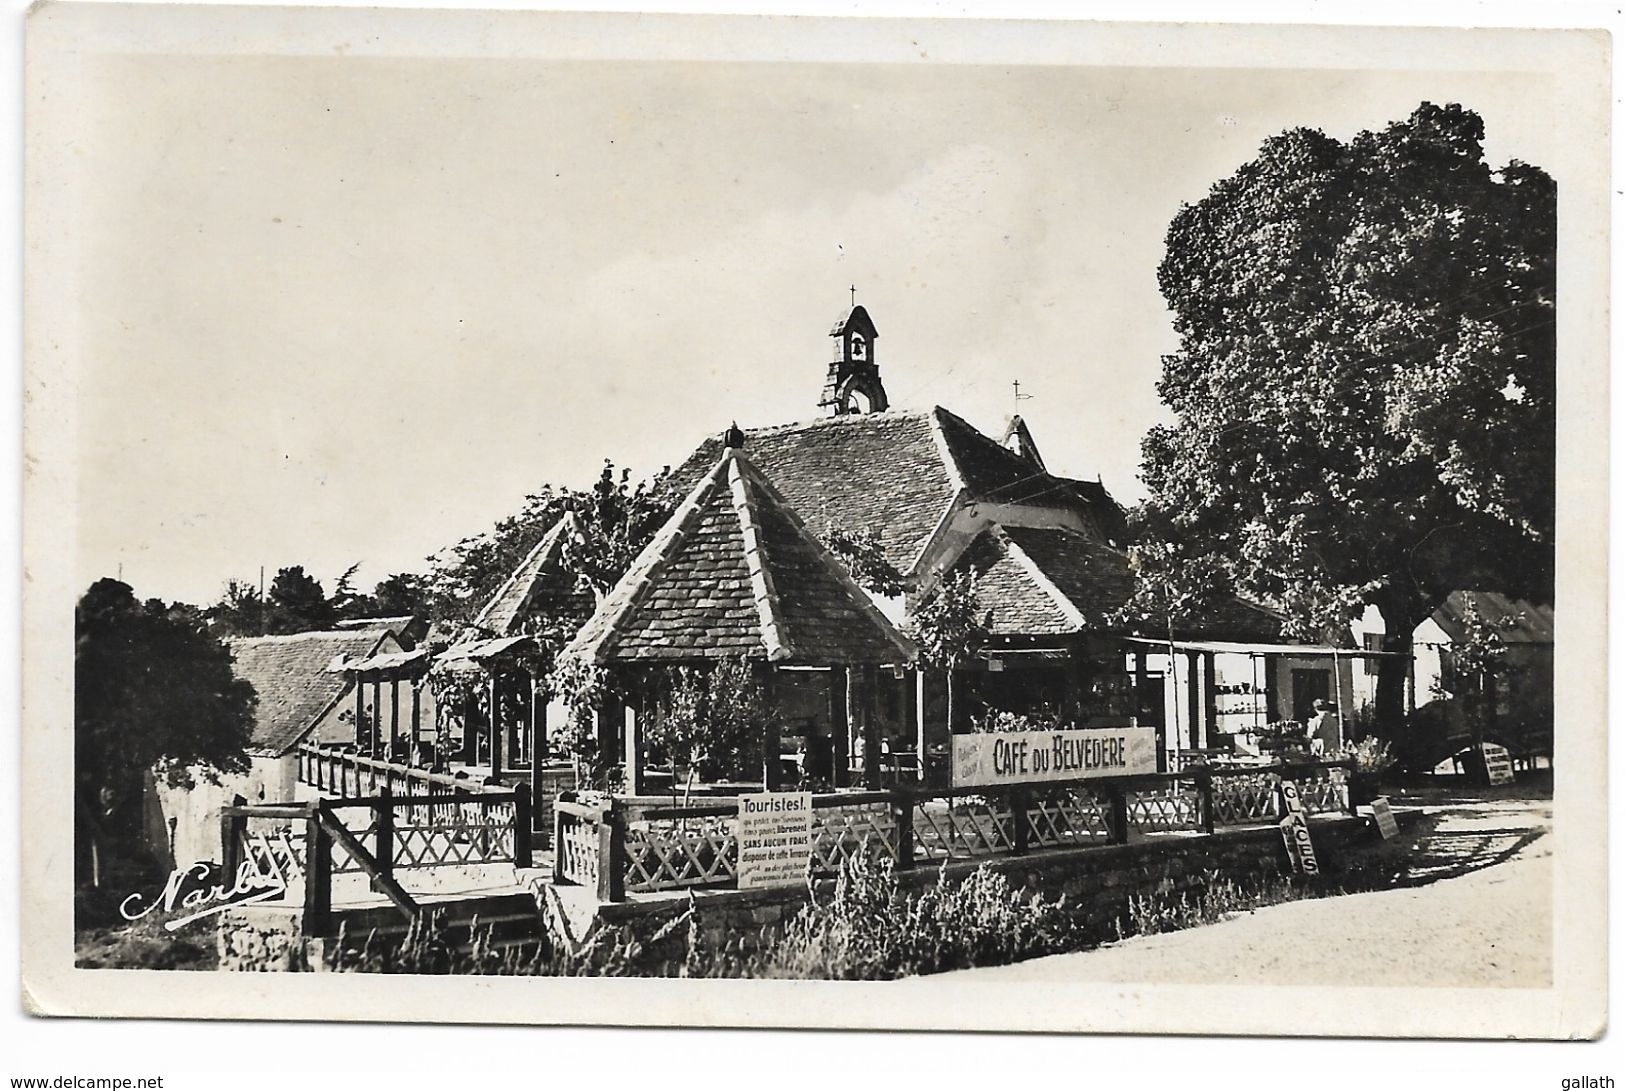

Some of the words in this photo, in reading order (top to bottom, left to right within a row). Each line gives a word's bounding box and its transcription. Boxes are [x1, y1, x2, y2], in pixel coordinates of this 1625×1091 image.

[993, 738, 1028, 775] CAFÉ
[1033, 748, 1049, 773] DU
[1283, 785, 1318, 873] GLACES
[744, 840, 761, 850] SANS
[763, 839, 787, 848] AUCUN
[789, 836, 808, 846] FRAIS
[768, 850, 775, 861] de
